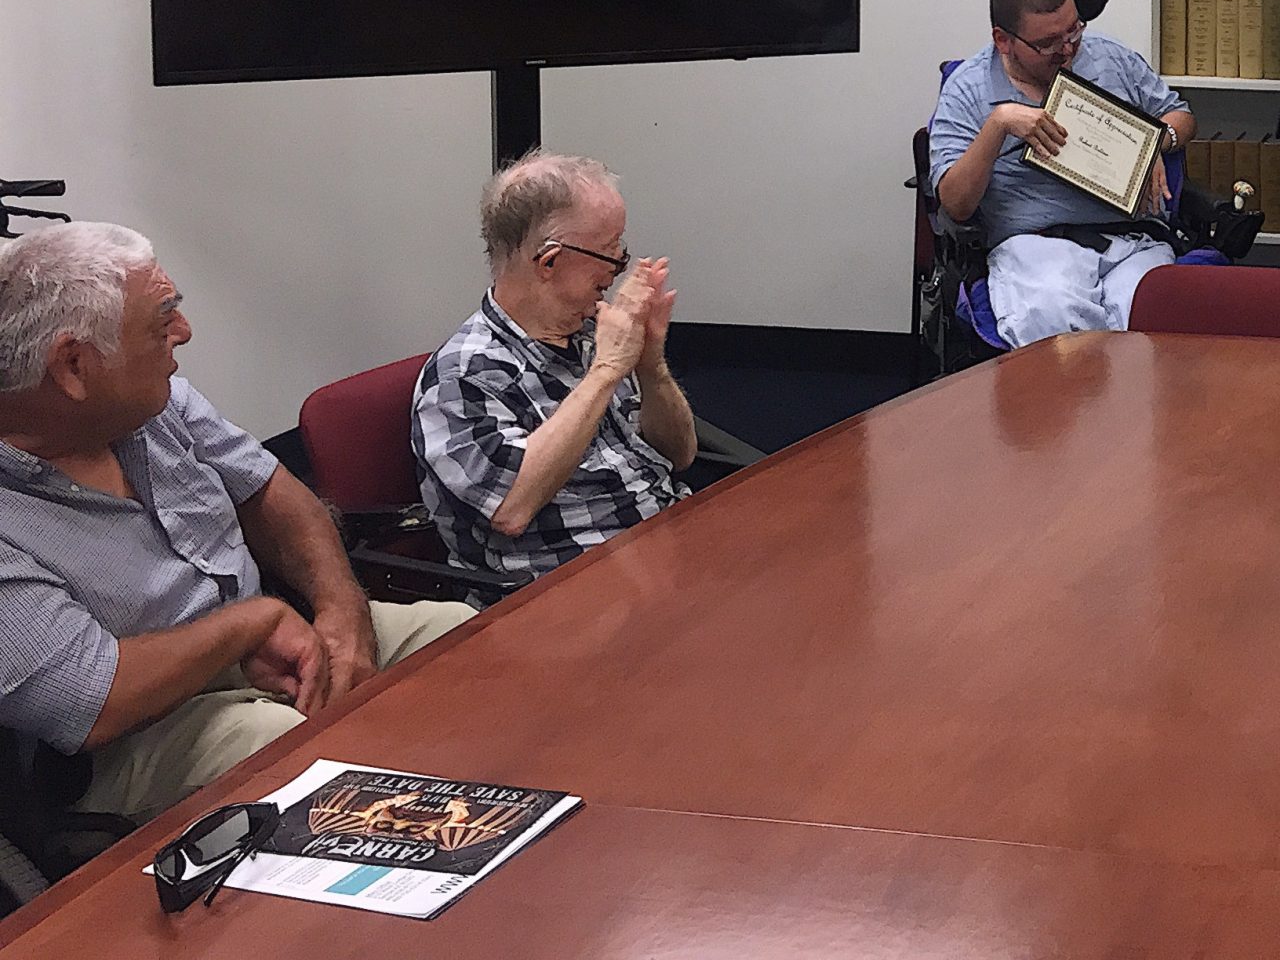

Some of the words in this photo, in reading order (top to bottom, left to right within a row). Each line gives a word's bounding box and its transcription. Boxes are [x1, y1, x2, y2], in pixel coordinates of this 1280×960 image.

[1065, 98, 1095, 118] Certificate
[369, 775, 424, 791] DATE
[424, 781, 468, 796] THE
[469, 785, 524, 801] SAVE
